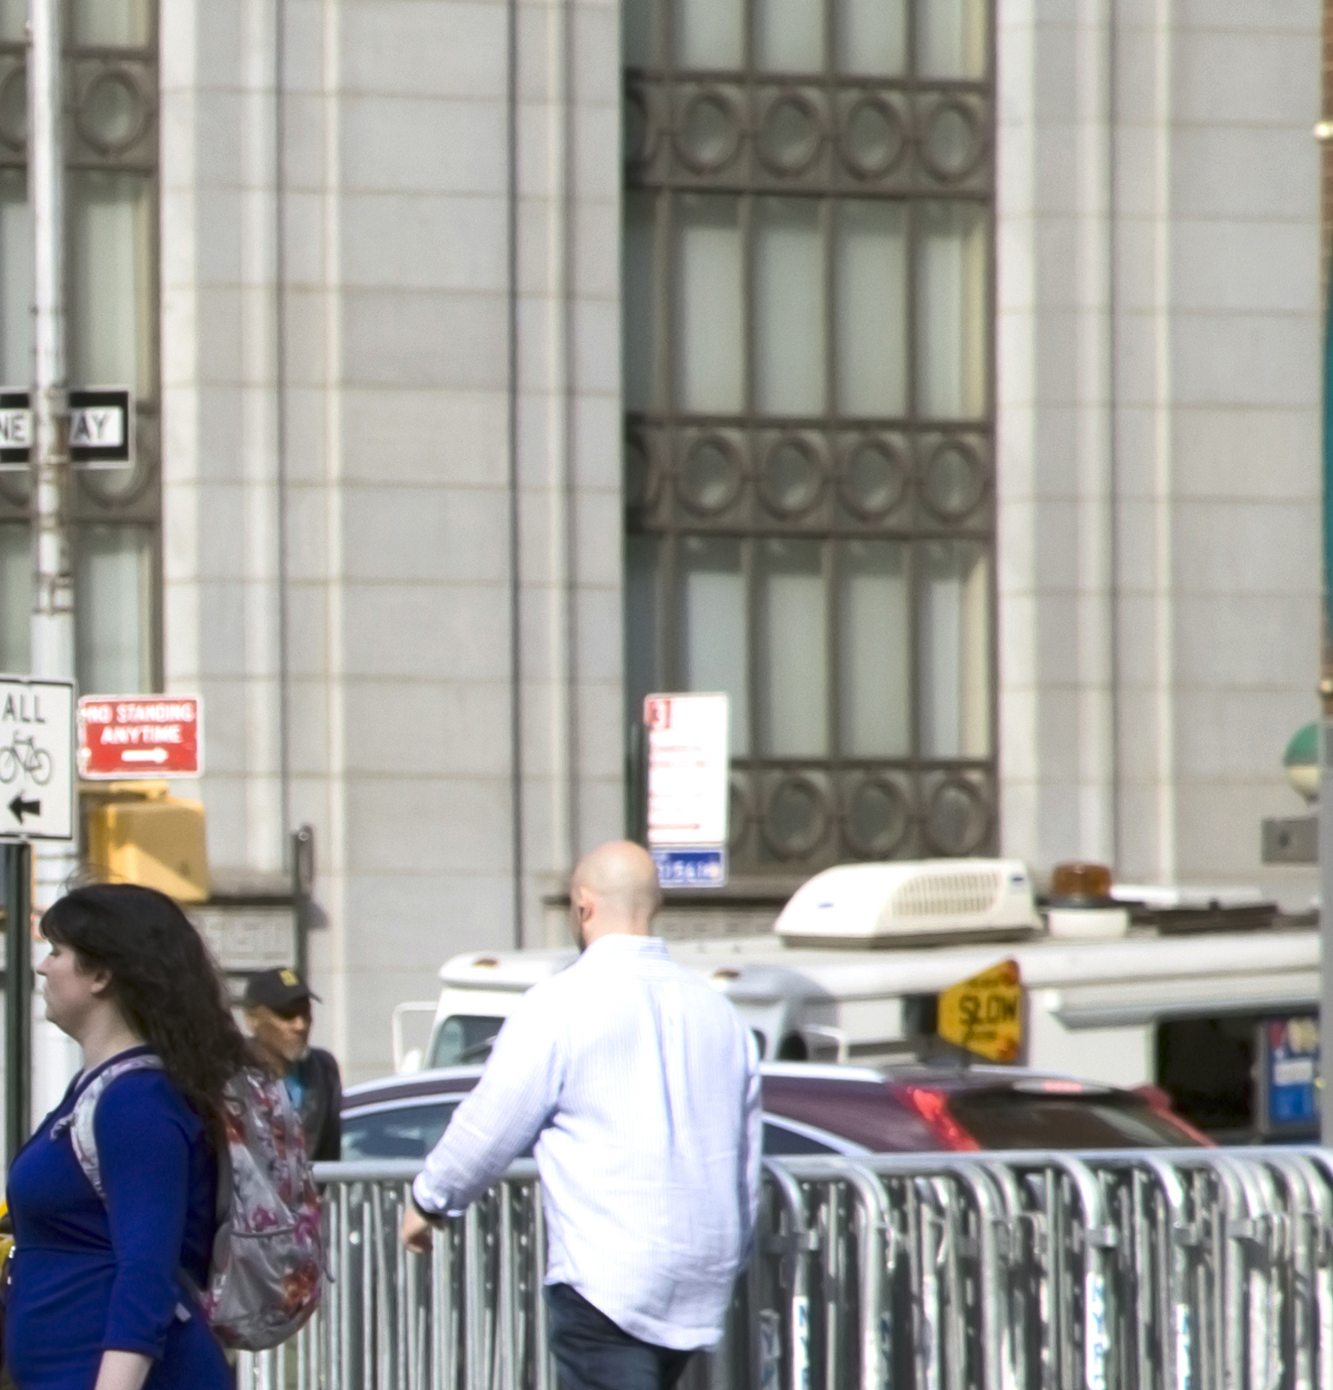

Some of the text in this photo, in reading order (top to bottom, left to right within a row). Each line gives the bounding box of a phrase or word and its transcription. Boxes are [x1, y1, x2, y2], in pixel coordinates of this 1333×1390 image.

[71, 413, 108, 443] AY
[1, 692, 46, 724] ALL
[85, 702, 195, 723] NO STANDING
[100, 724, 183, 745] ANYTIME
[958, 993, 1017, 1024] SLOW
